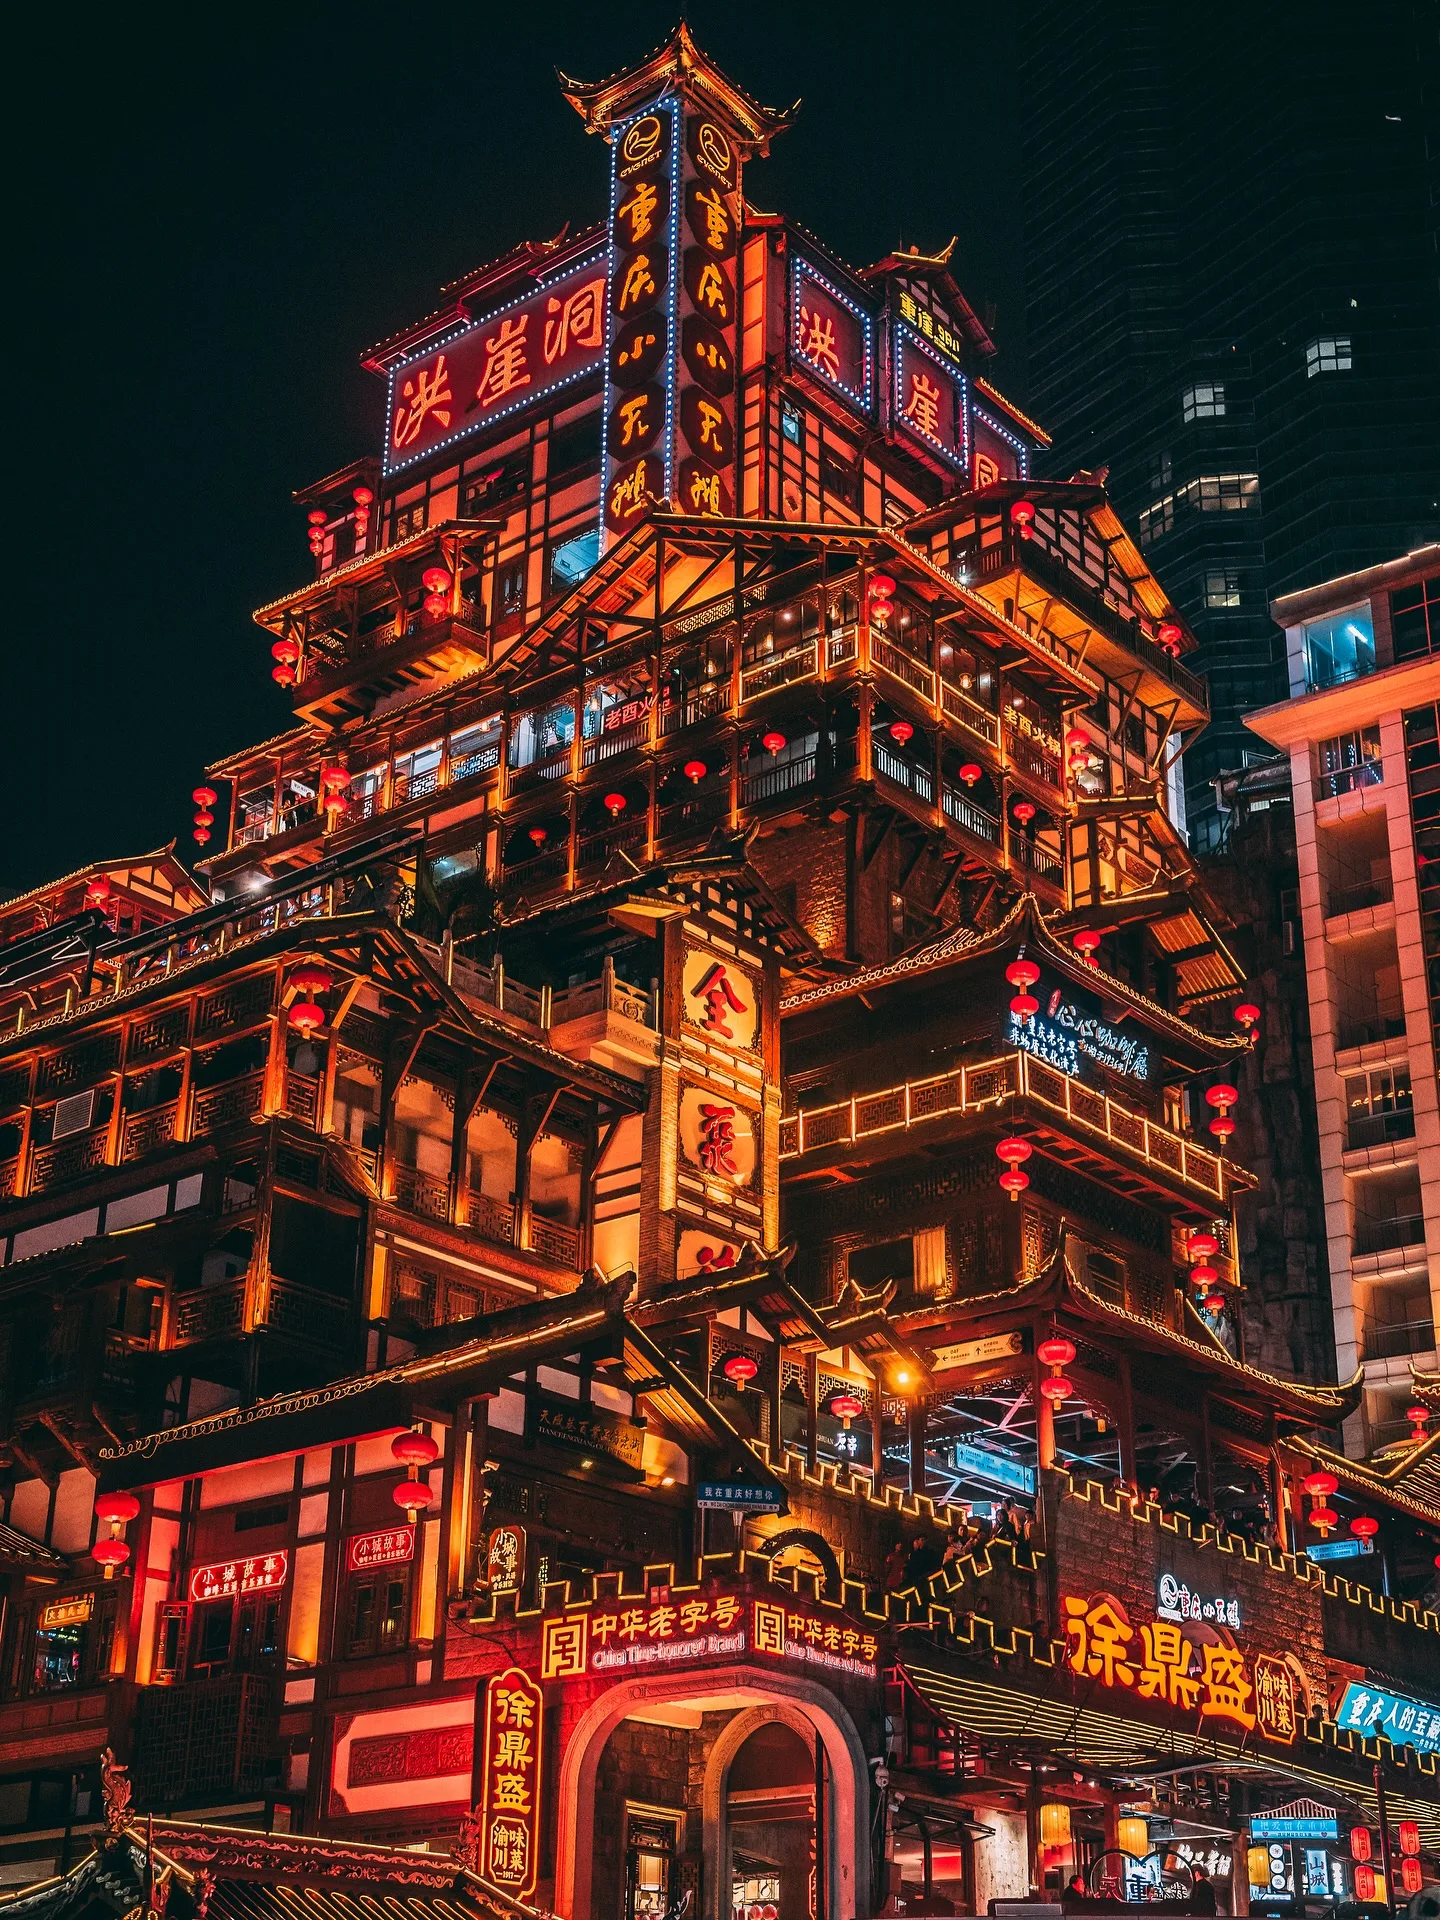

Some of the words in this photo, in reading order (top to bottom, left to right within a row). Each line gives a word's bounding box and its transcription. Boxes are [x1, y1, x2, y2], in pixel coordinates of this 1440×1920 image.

[394, 278, 605, 449] 洪崖洞
[704, 1487, 774, 1501] 我在重庆好想你
[360, 1533, 407, 1555] 小城故事
[202, 1556, 277, 1585] 小城故事
[592, 1596, 741, 1645] 中华老字号
[787, 1613, 878, 1661] 中华老字号
[592, 1646, 627, 1669] China
[627, 1635, 706, 1664] Time-honored
[708, 1629, 746, 1656] Brand
[1065, 1596, 1257, 1731] 徐鼎盛
[492, 1688, 535, 1815] 徐鼎盛
[1260, 1820, 1329, 1831] 把爱留在重庆
[1309, 1856, 1328, 1888] 山城
